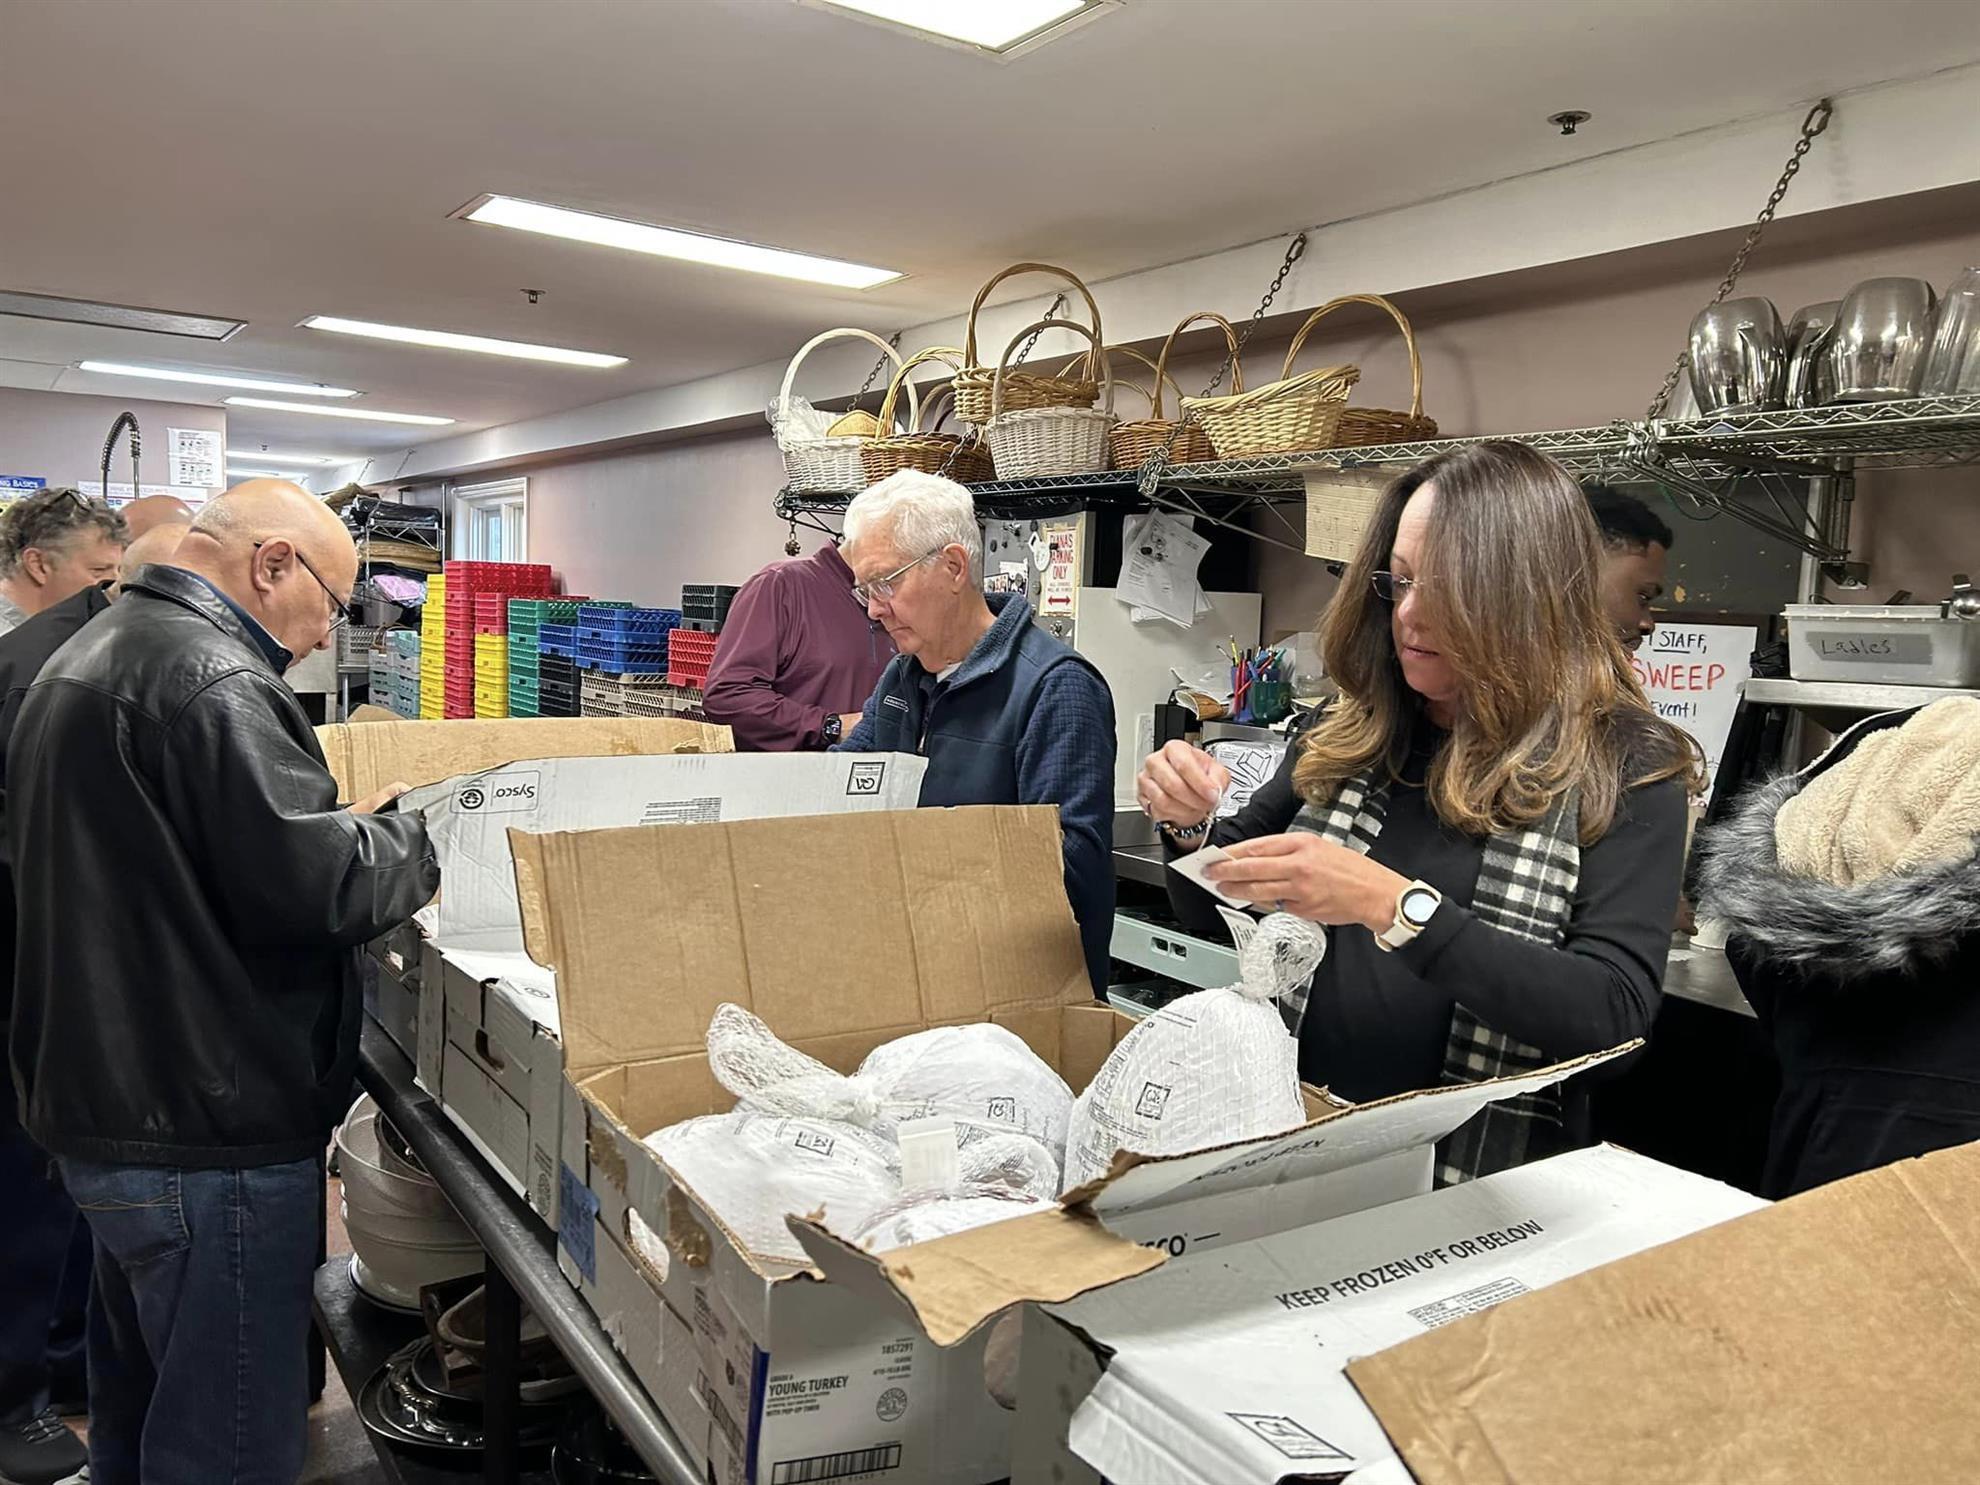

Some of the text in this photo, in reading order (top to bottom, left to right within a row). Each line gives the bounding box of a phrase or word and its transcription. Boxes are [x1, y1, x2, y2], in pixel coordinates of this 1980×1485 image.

[1049, 549, 1073, 564] ARKING
[1053, 565, 1067, 580] ONLY
[1659, 631, 1707, 654] STAFF,
[1821, 639, 1891, 655] Ladles
[1630, 658, 1725, 690] SWEEP
[495, 783, 536, 799] Sysco
[1275, 1286, 1331, 1310] KEEP
[1330, 1258, 1420, 1298] FROZEN
[1447, 1239, 1483, 1259] OR
[1475, 1219, 1544, 1250] BELOW
[769, 1380, 807, 1397] YOUNG
[808, 1376, 849, 1392] TURKEY
